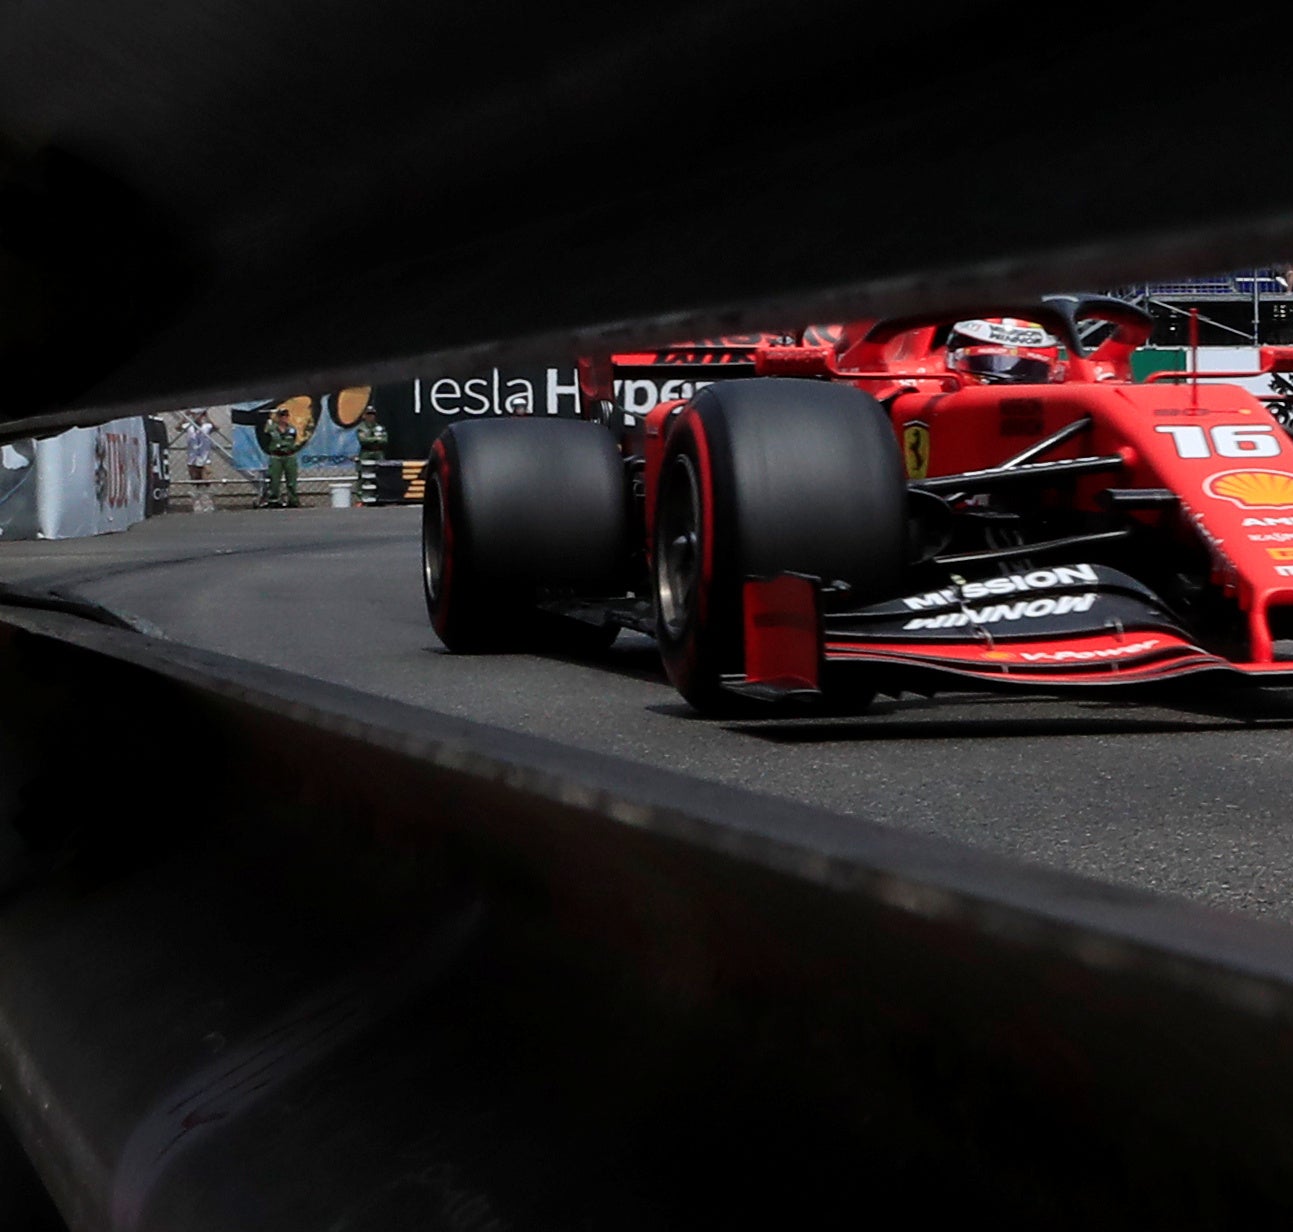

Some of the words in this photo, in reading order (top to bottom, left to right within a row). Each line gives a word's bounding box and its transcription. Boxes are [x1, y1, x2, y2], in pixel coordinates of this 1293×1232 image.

[547, 368, 714, 426] Hpe
[1154, 424, 1282, 459] 16
[902, 563, 1099, 610] MISSION
[902, 593, 1099, 630] WINNOW
